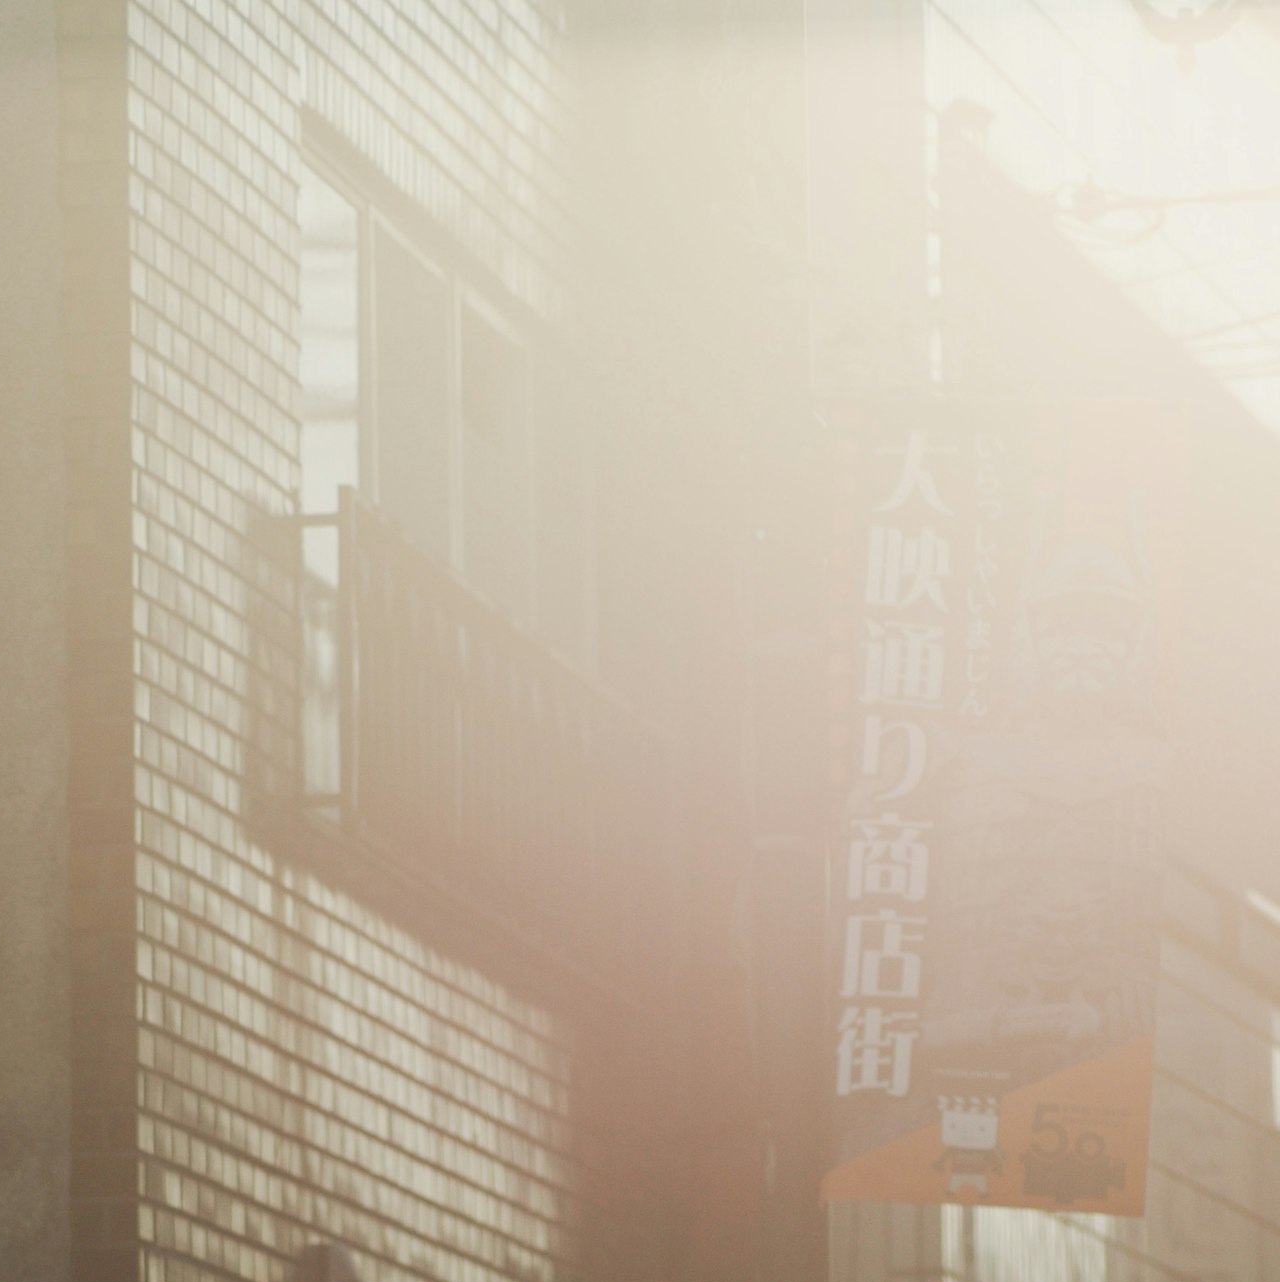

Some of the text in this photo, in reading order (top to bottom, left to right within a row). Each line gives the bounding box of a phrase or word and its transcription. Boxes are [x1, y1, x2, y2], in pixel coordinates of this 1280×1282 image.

[836, 430, 960, 1097] 大映通り商店街
